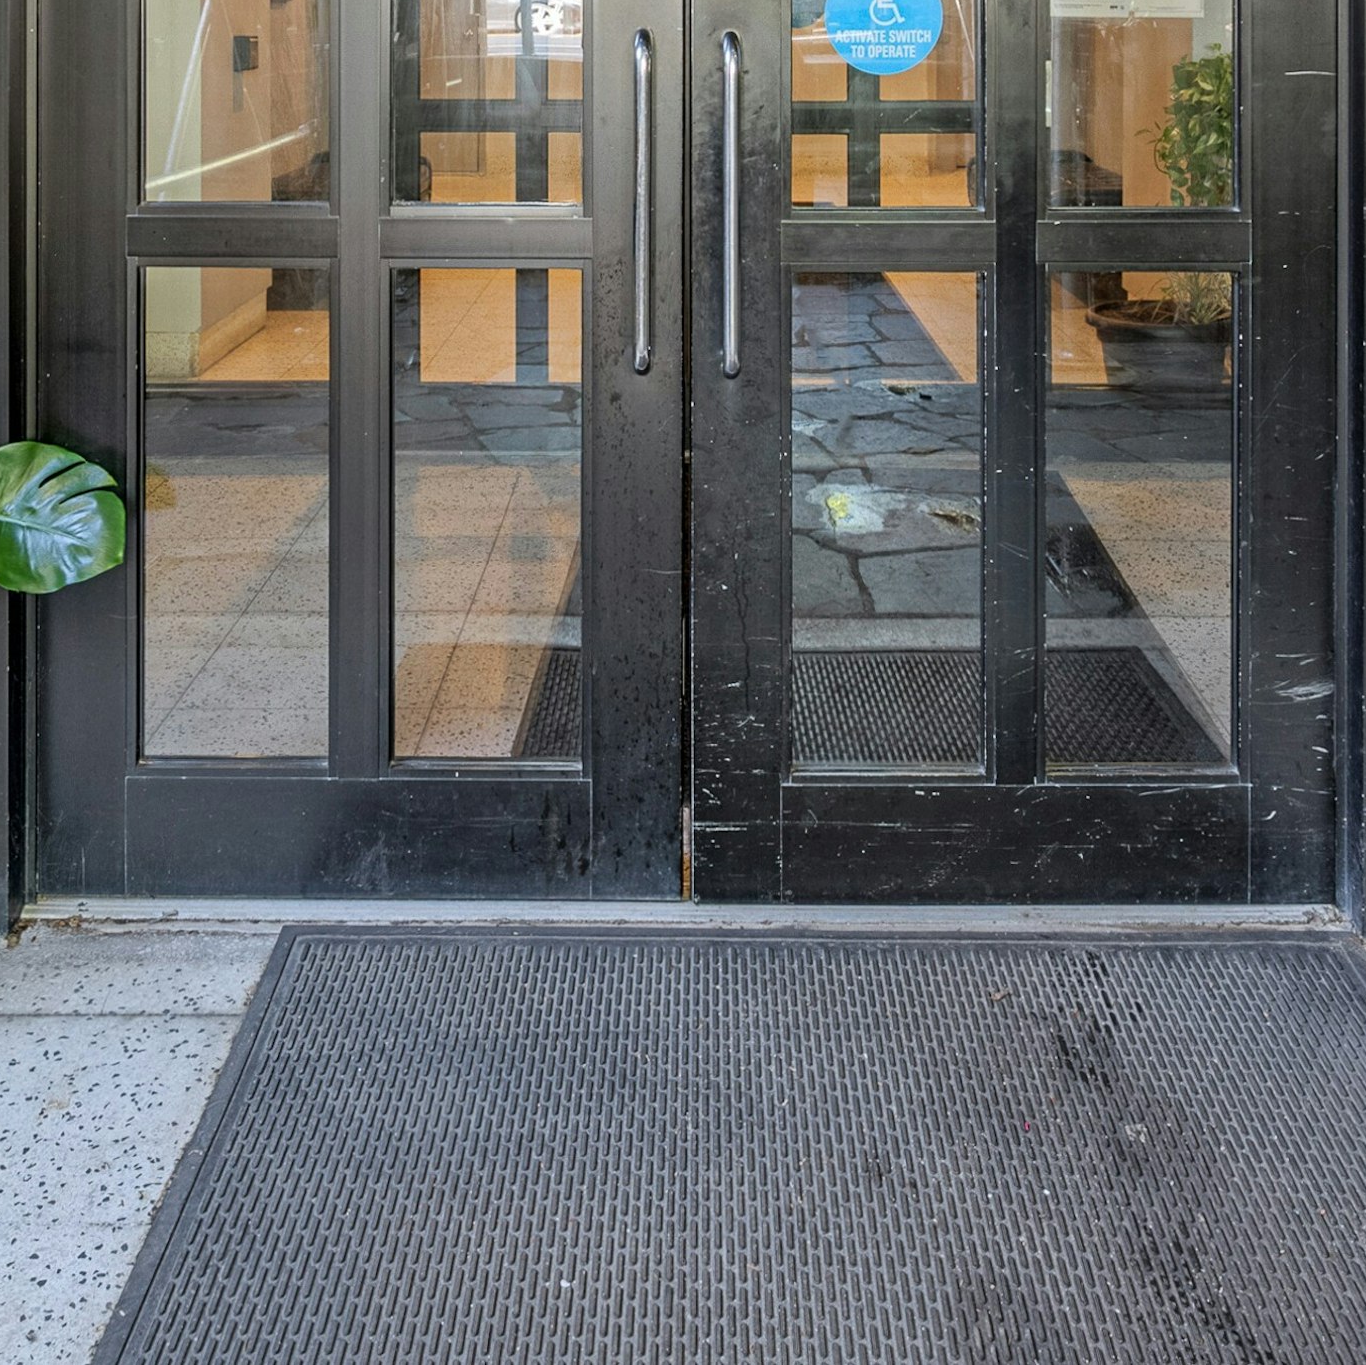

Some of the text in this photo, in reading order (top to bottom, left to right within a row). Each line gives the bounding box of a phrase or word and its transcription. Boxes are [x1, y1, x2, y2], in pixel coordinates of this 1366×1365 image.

[835, 30, 931, 43] ACTIVATE SWITCH
[851, 45, 916, 58] TO OPERATE
